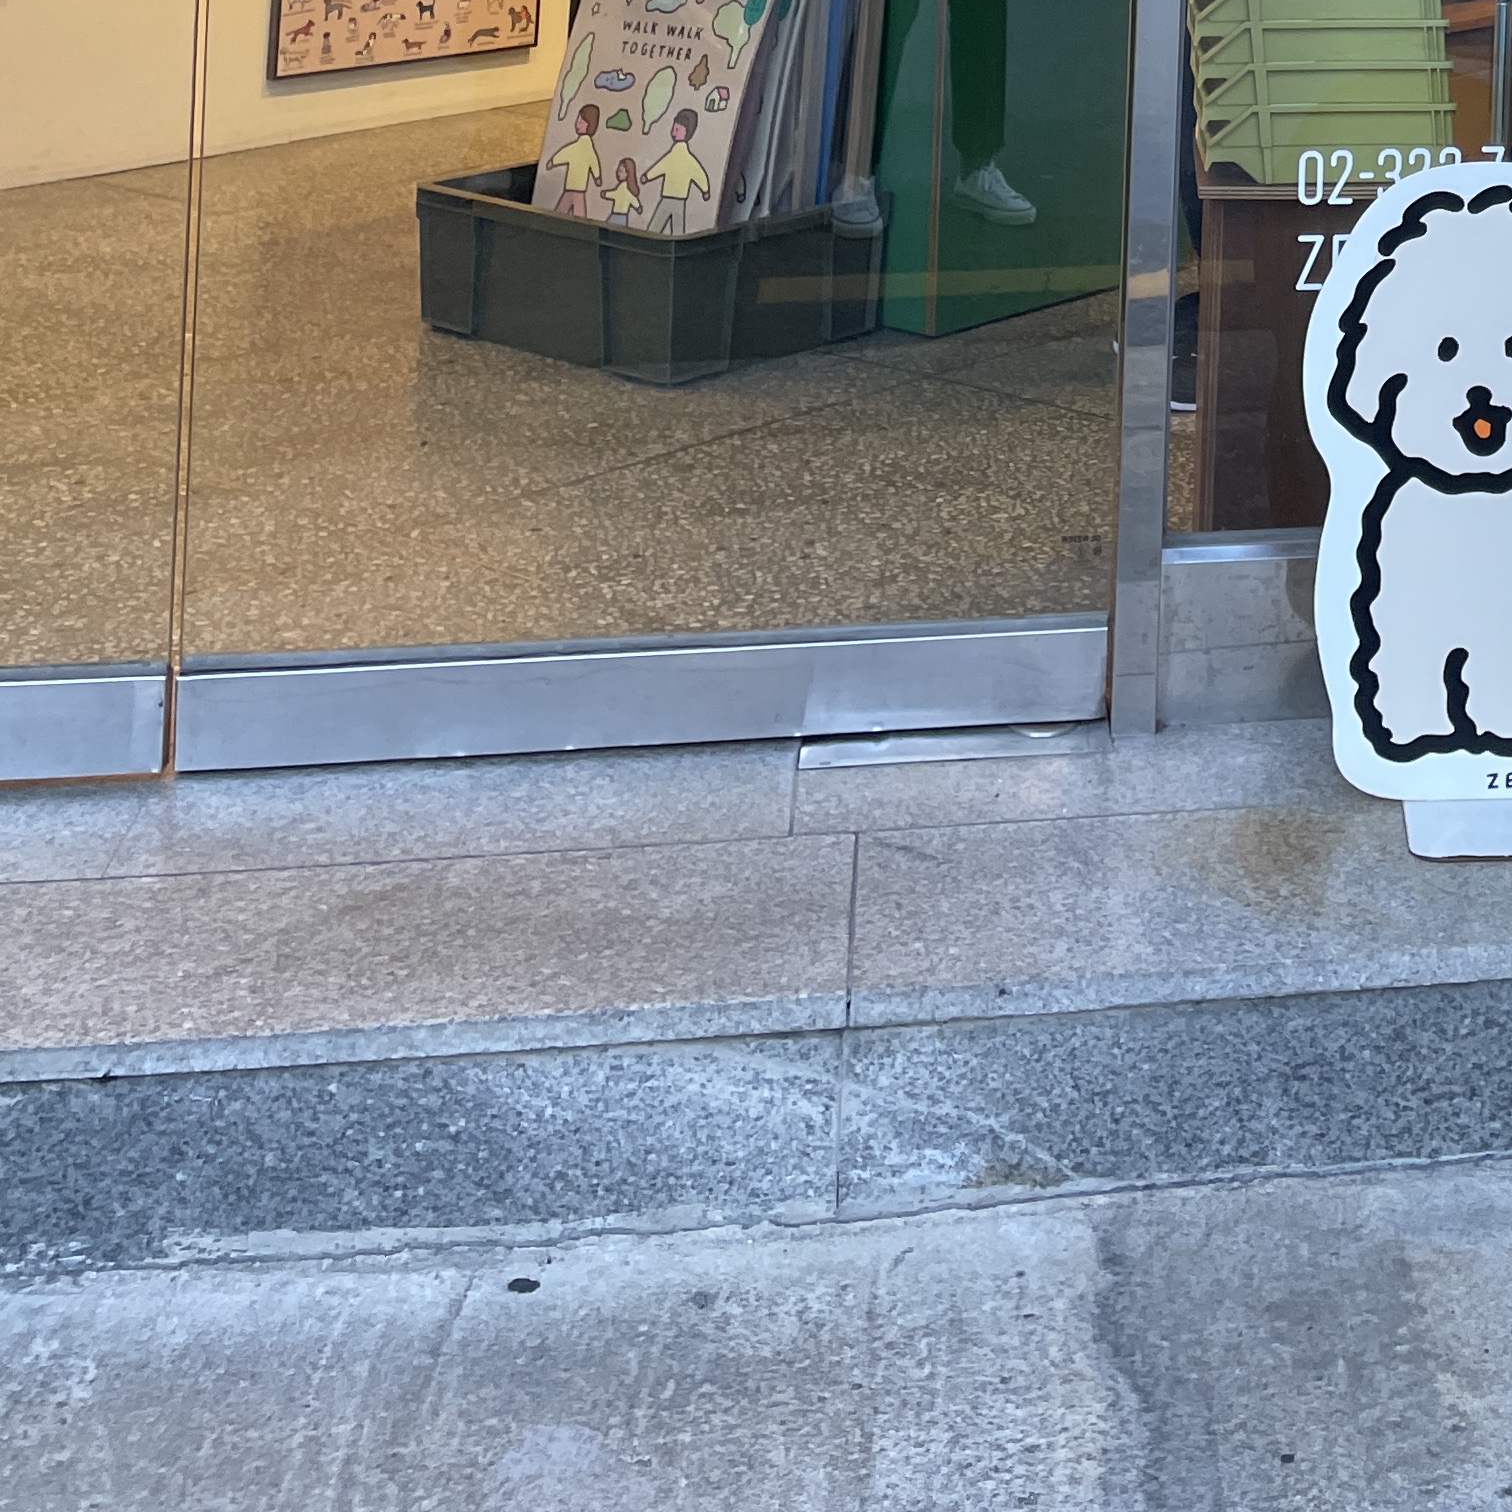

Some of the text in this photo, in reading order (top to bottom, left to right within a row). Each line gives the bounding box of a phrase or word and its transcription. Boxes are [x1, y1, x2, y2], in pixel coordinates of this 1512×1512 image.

[623, 20, 704, 40] WALK WALK
[621, 41, 692, 61] TOGETHER
